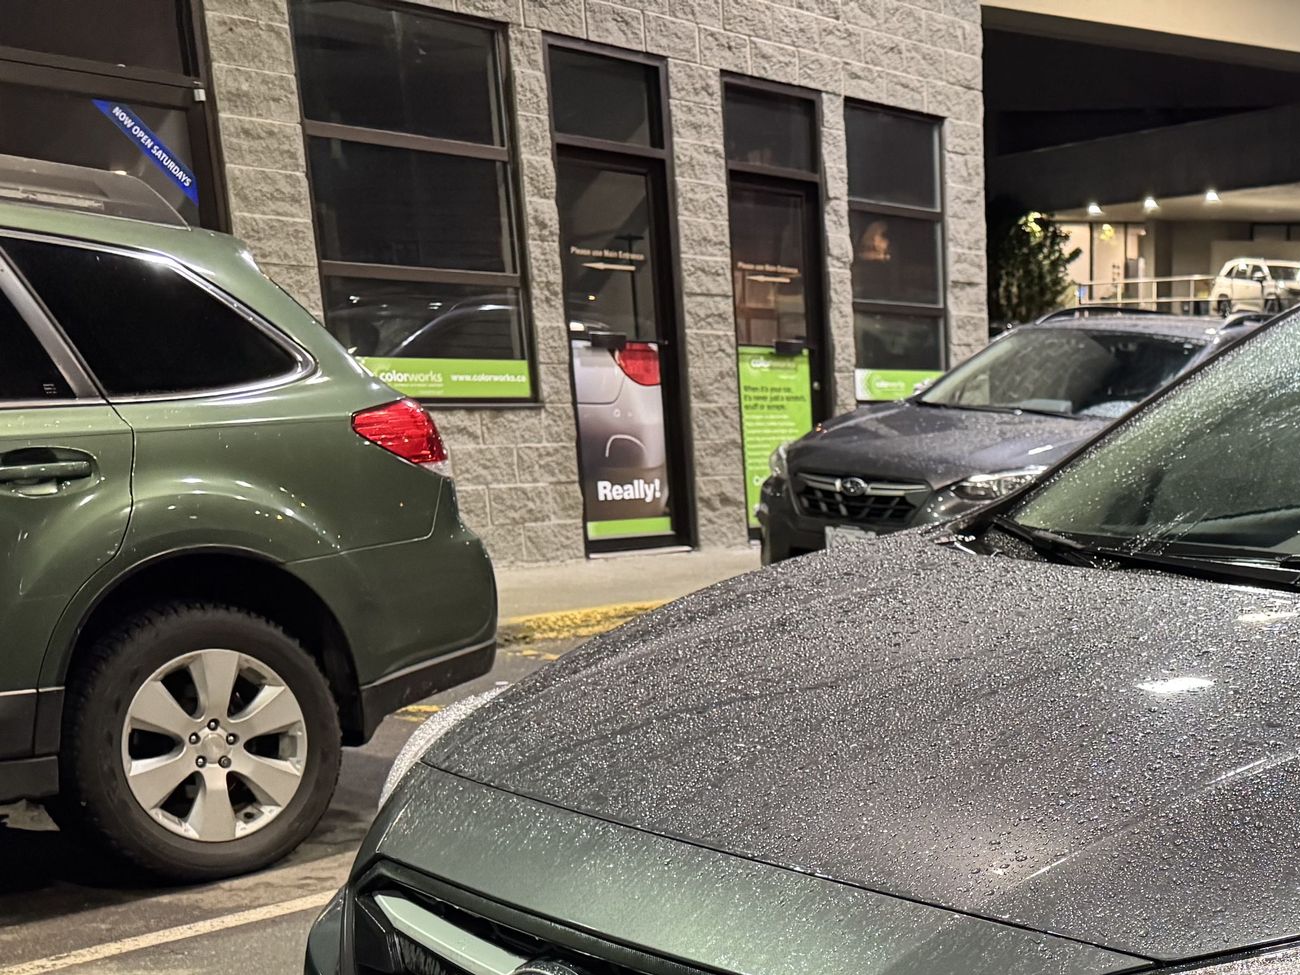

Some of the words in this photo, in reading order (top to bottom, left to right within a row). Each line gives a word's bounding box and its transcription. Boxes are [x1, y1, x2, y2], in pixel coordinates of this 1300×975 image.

[112, 106, 135, 128] NOW
[131, 126, 154, 149] OPEN
[151, 145, 192, 187] SATURDAYS
[379, 370, 443, 383] colorworks
[597, 478, 661, 502] Really!
